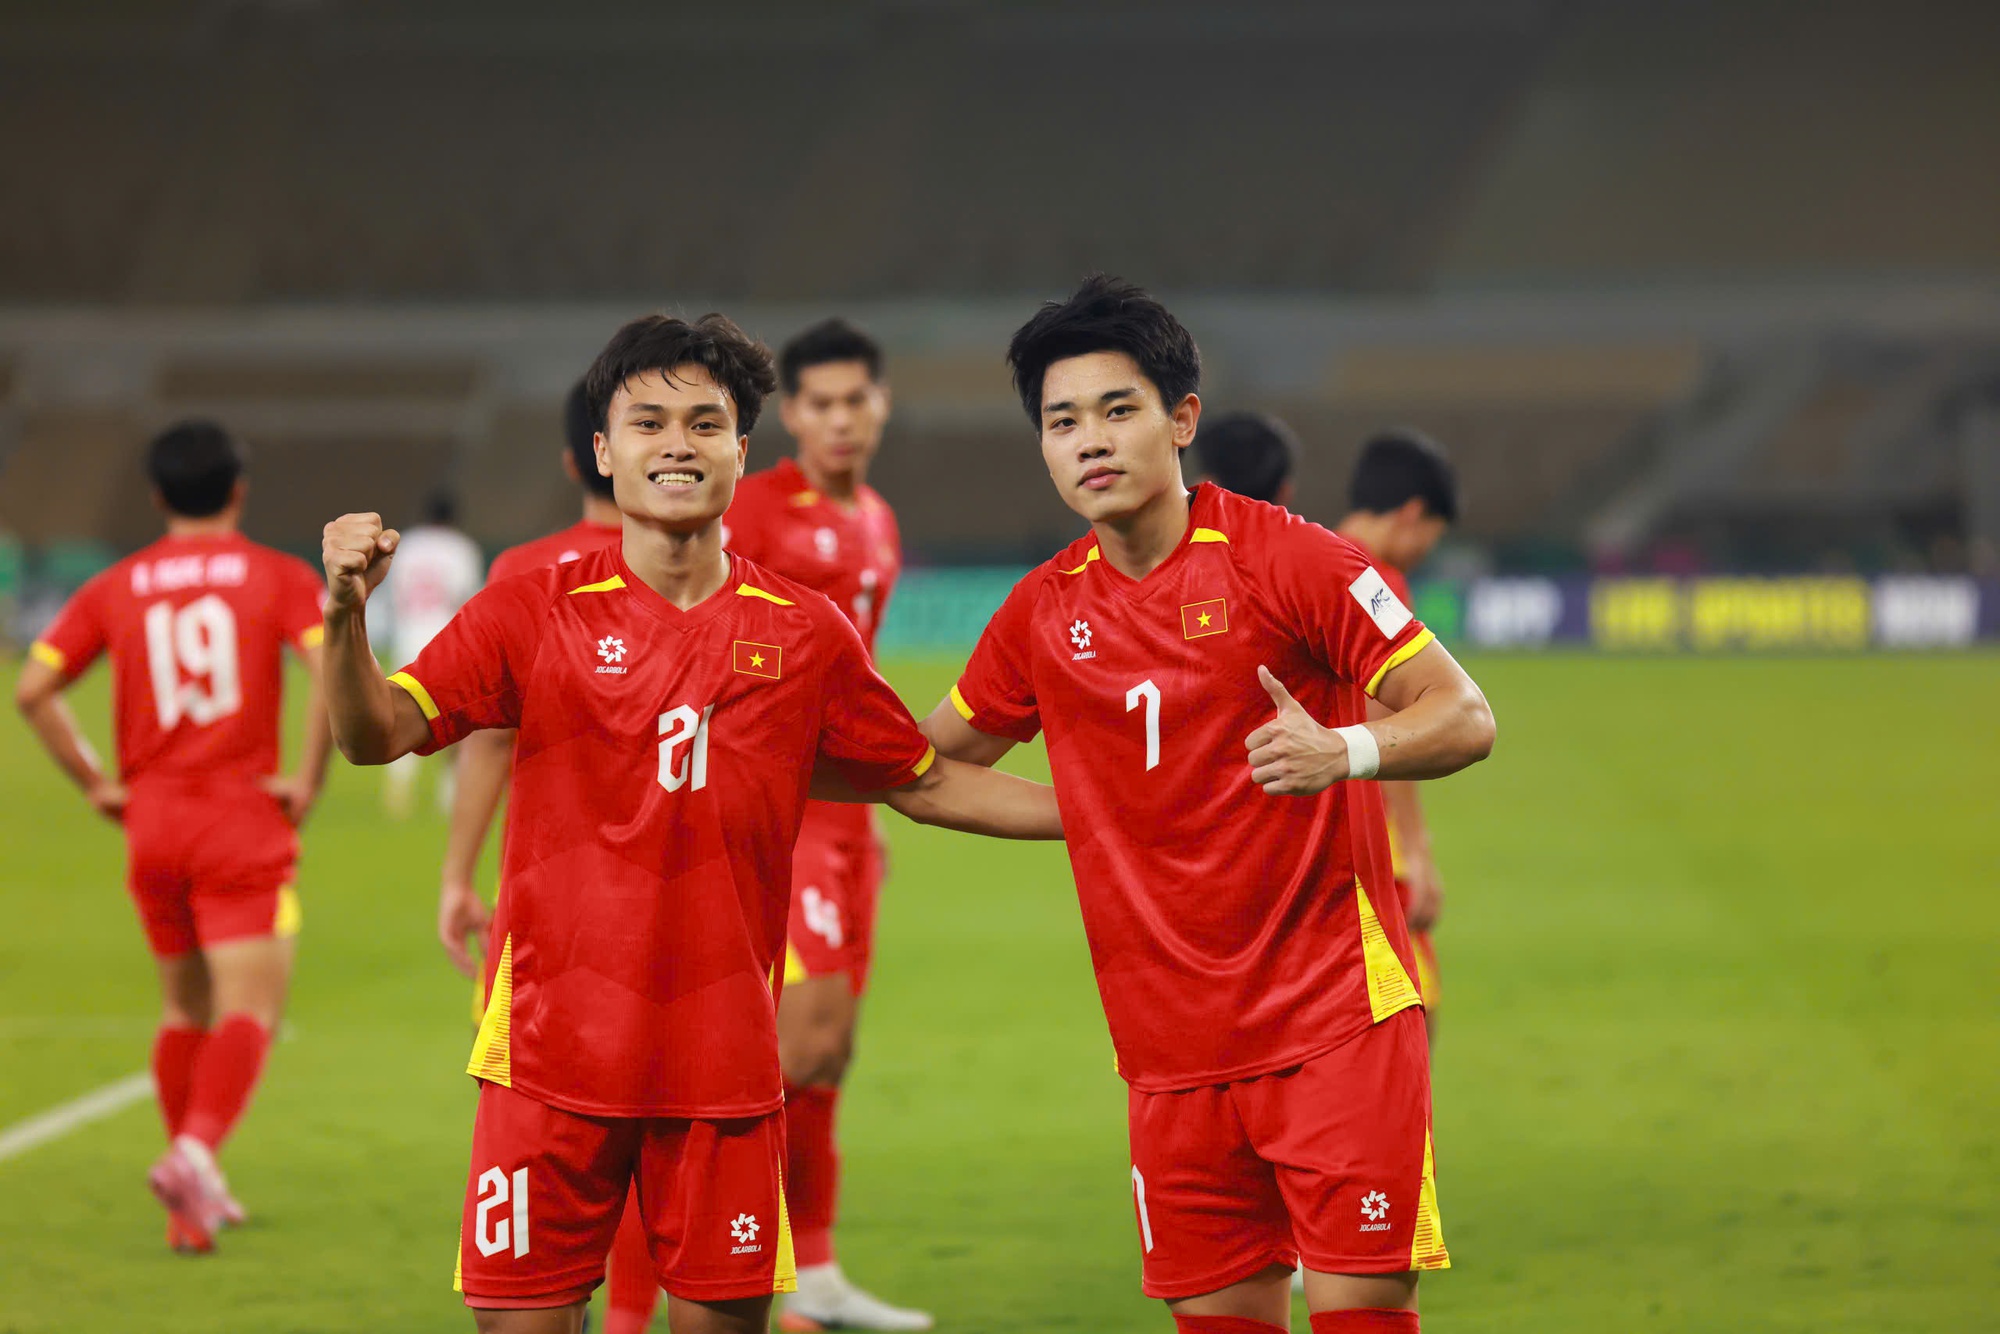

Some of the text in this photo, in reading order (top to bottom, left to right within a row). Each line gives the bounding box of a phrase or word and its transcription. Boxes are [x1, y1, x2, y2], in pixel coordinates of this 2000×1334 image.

[145, 594, 243, 732] 19
[657, 702, 715, 793] 21
[1126, 679, 1160, 772] 7
[475, 1165, 530, 1260] 21
